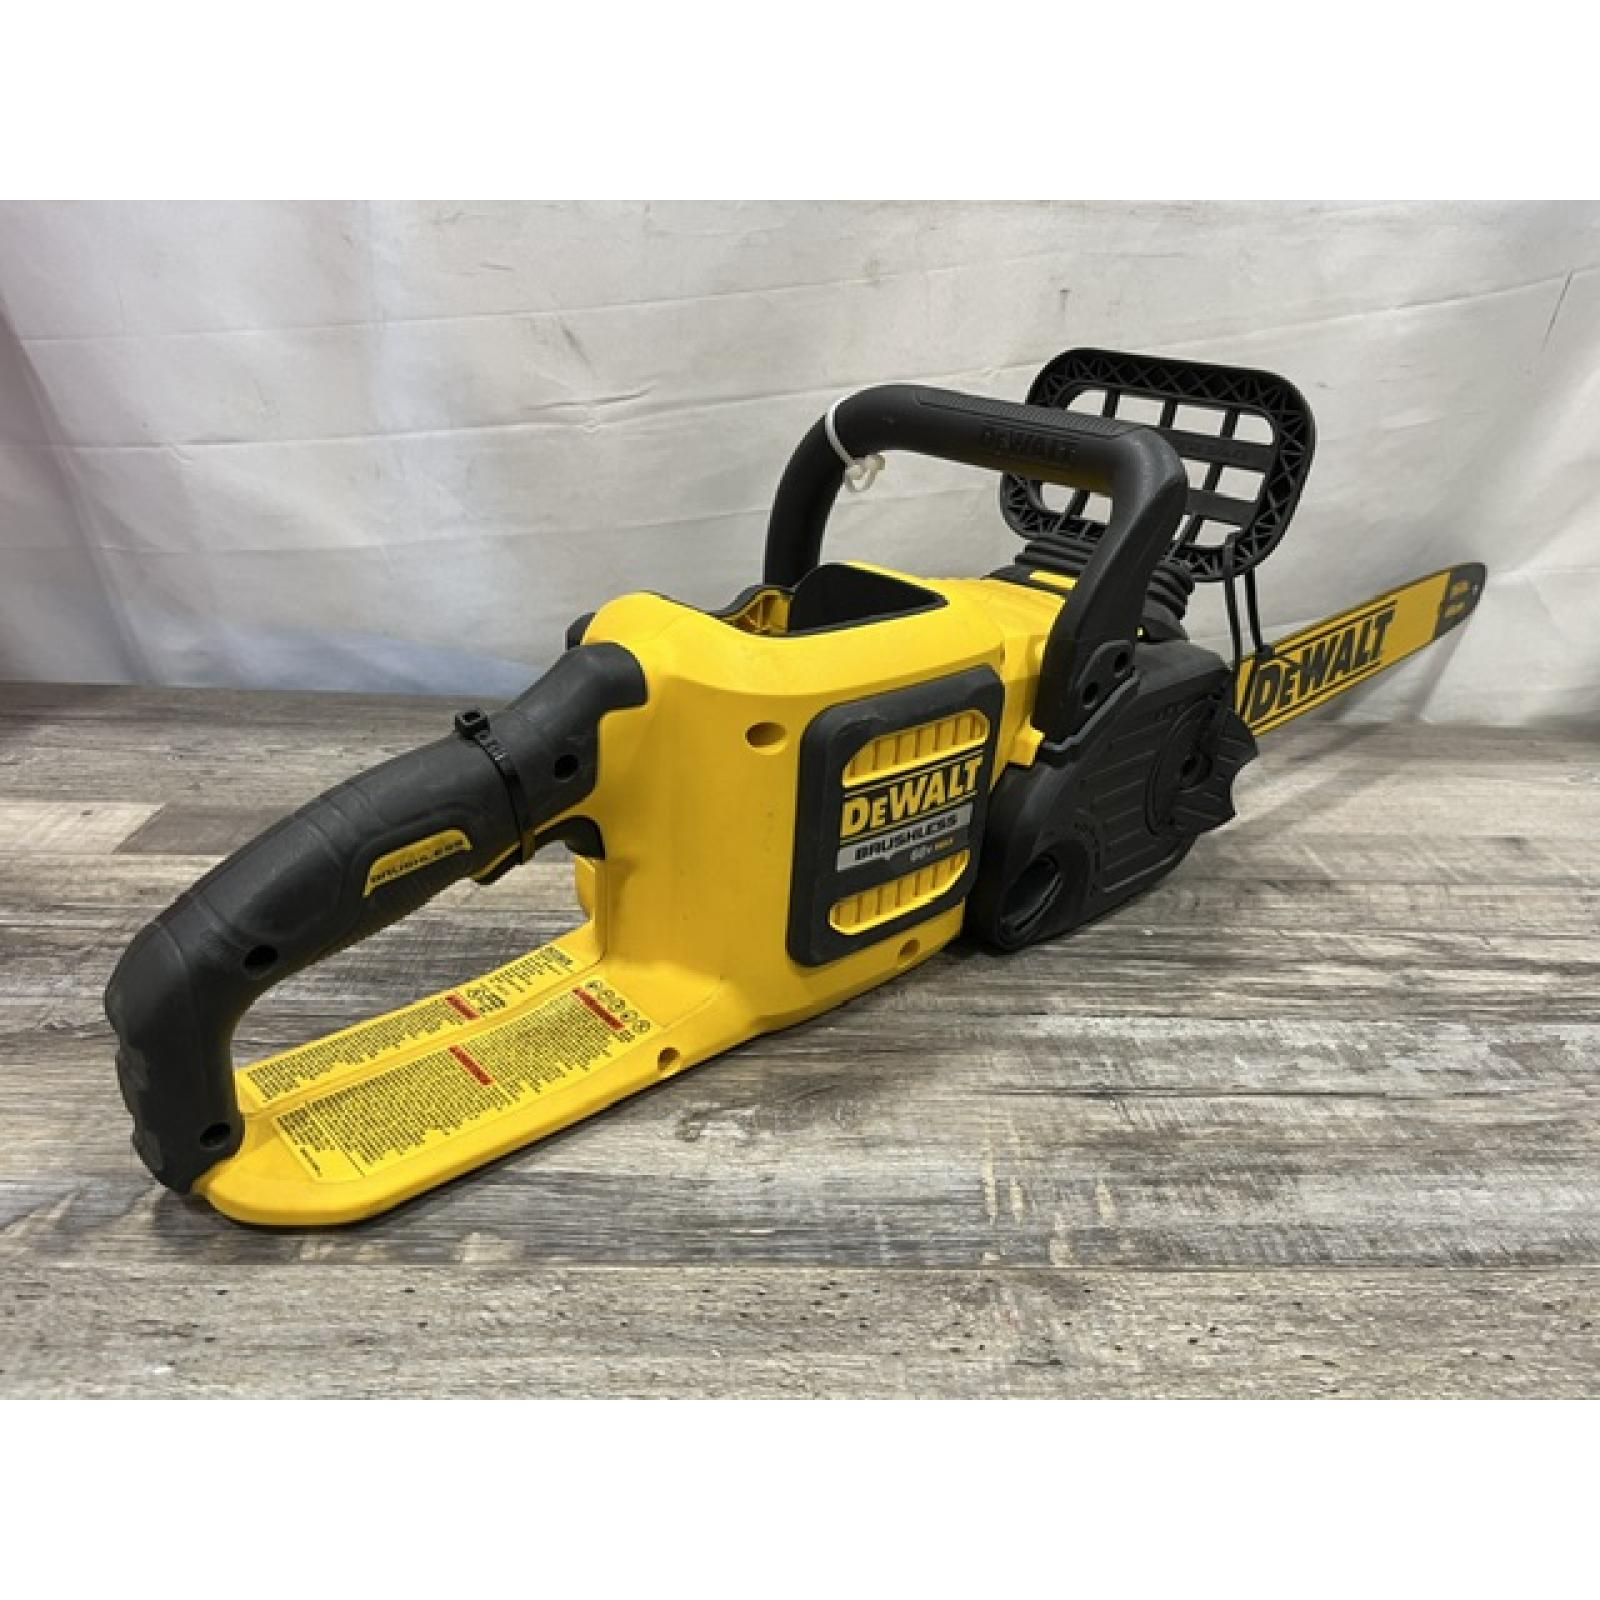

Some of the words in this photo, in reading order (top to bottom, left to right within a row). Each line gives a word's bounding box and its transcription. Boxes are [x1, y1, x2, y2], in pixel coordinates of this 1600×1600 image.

[1250, 608, 1396, 720] DEWALT
[841, 757, 982, 838] DEWALT
[856, 813, 958, 860] BRUSHLESS
